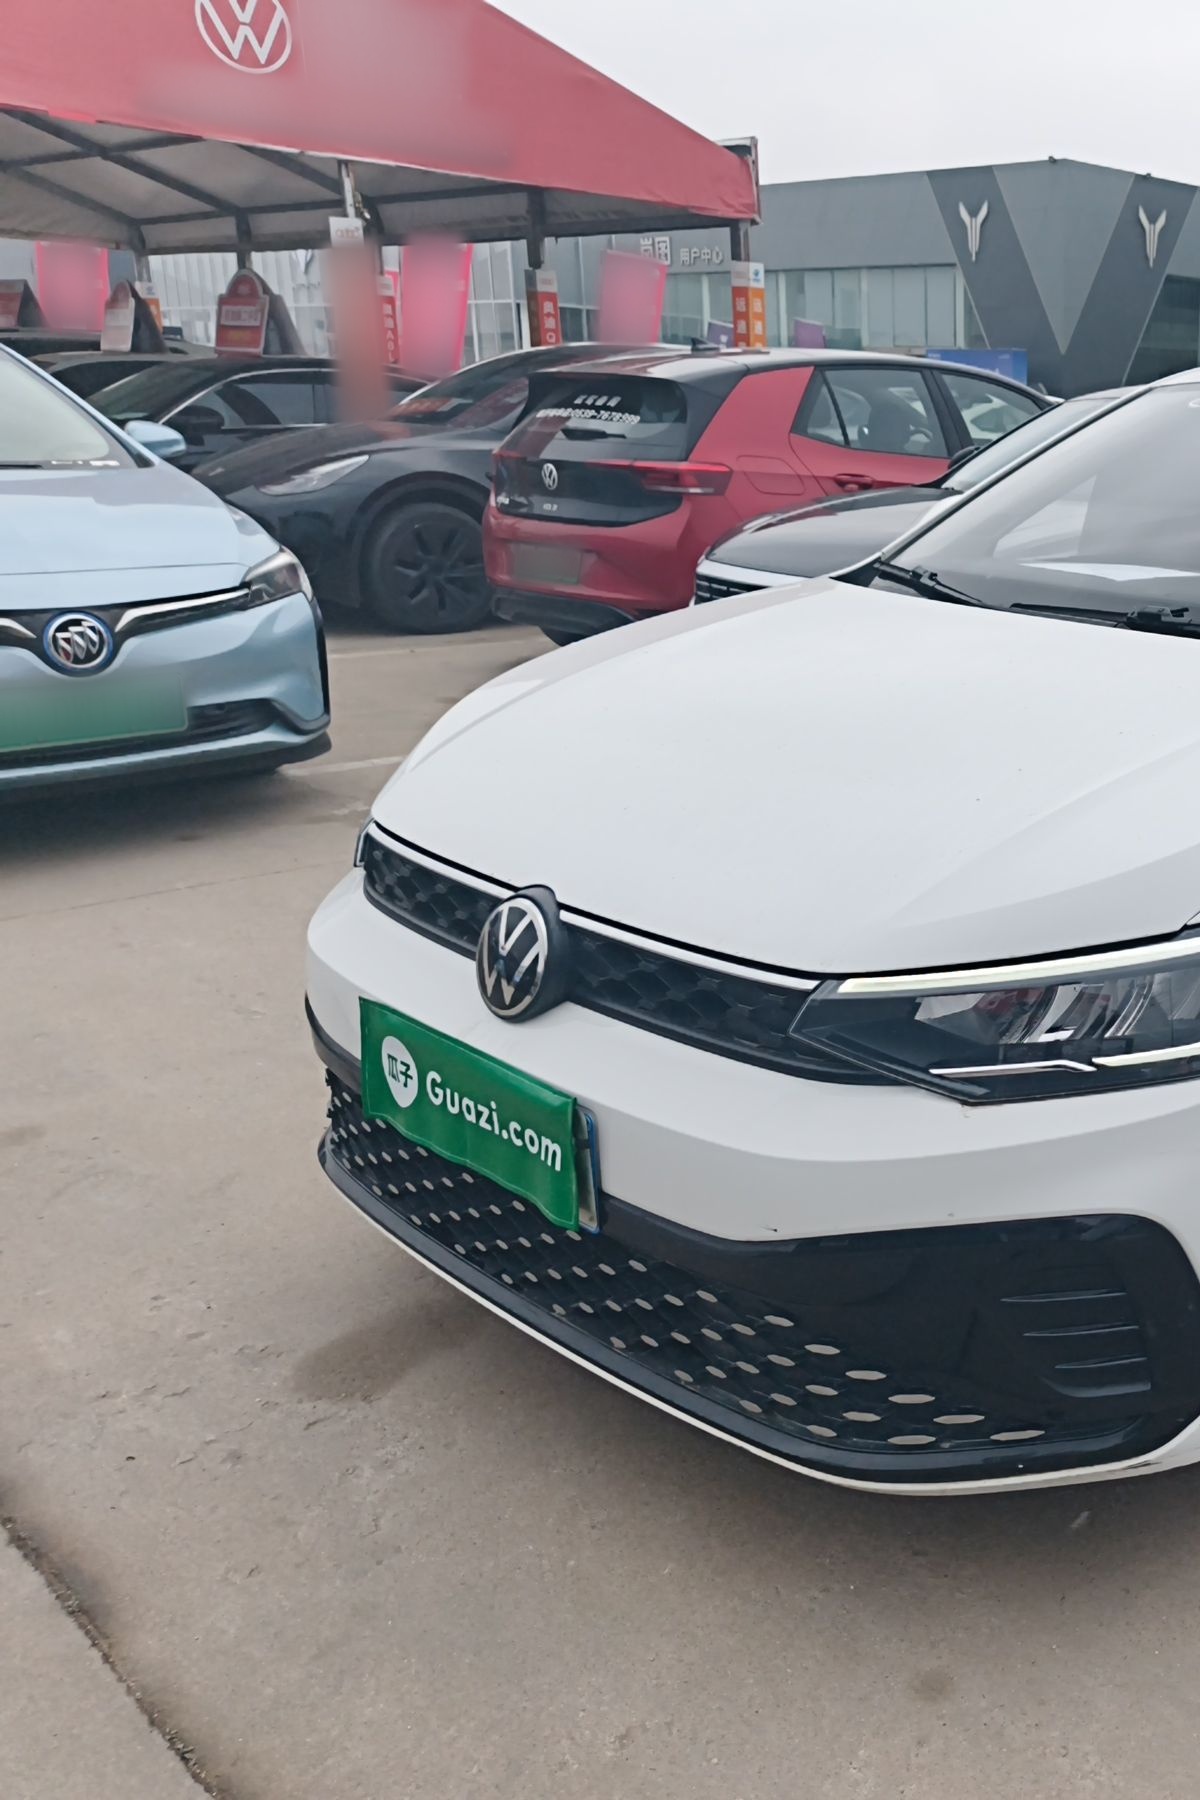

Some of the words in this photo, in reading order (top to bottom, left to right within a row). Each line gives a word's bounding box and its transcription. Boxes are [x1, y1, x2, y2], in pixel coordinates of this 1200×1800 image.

[680, 246, 723, 265] 用户中心
[478, 900, 546, 1011] VW
[386, 1053, 413, 1088] 瓜子
[425, 1070, 562, 1172] Guazi.com
